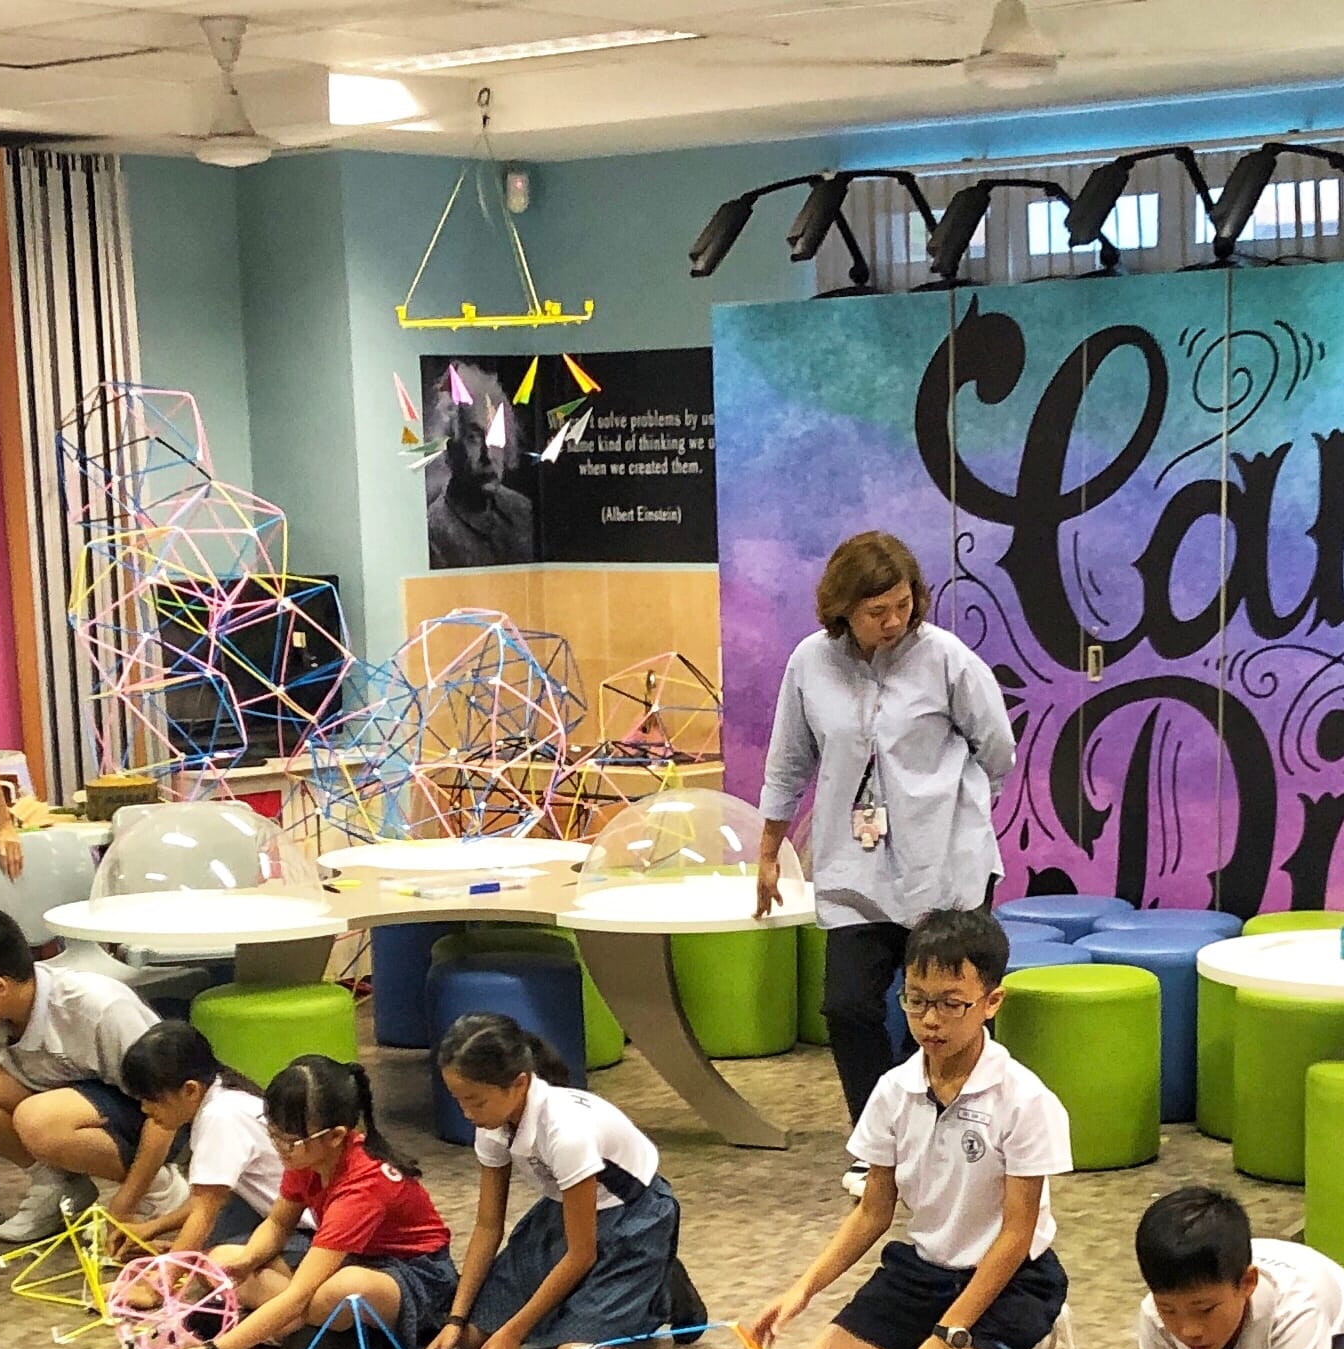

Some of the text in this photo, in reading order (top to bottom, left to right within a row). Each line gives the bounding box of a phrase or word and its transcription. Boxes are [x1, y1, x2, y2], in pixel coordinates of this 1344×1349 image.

[597, 410, 627, 428] solve
[630, 409, 681, 432] problems
[685, 408, 697, 430] by
[598, 434, 622, 452] kind
[625, 434, 635, 452] of
[638, 433, 685, 455] thinking
[689, 437, 704, 450] we
[579, 456, 704, 475] when we created them.
[601, 506, 682, 525] (Albert Einstein)
